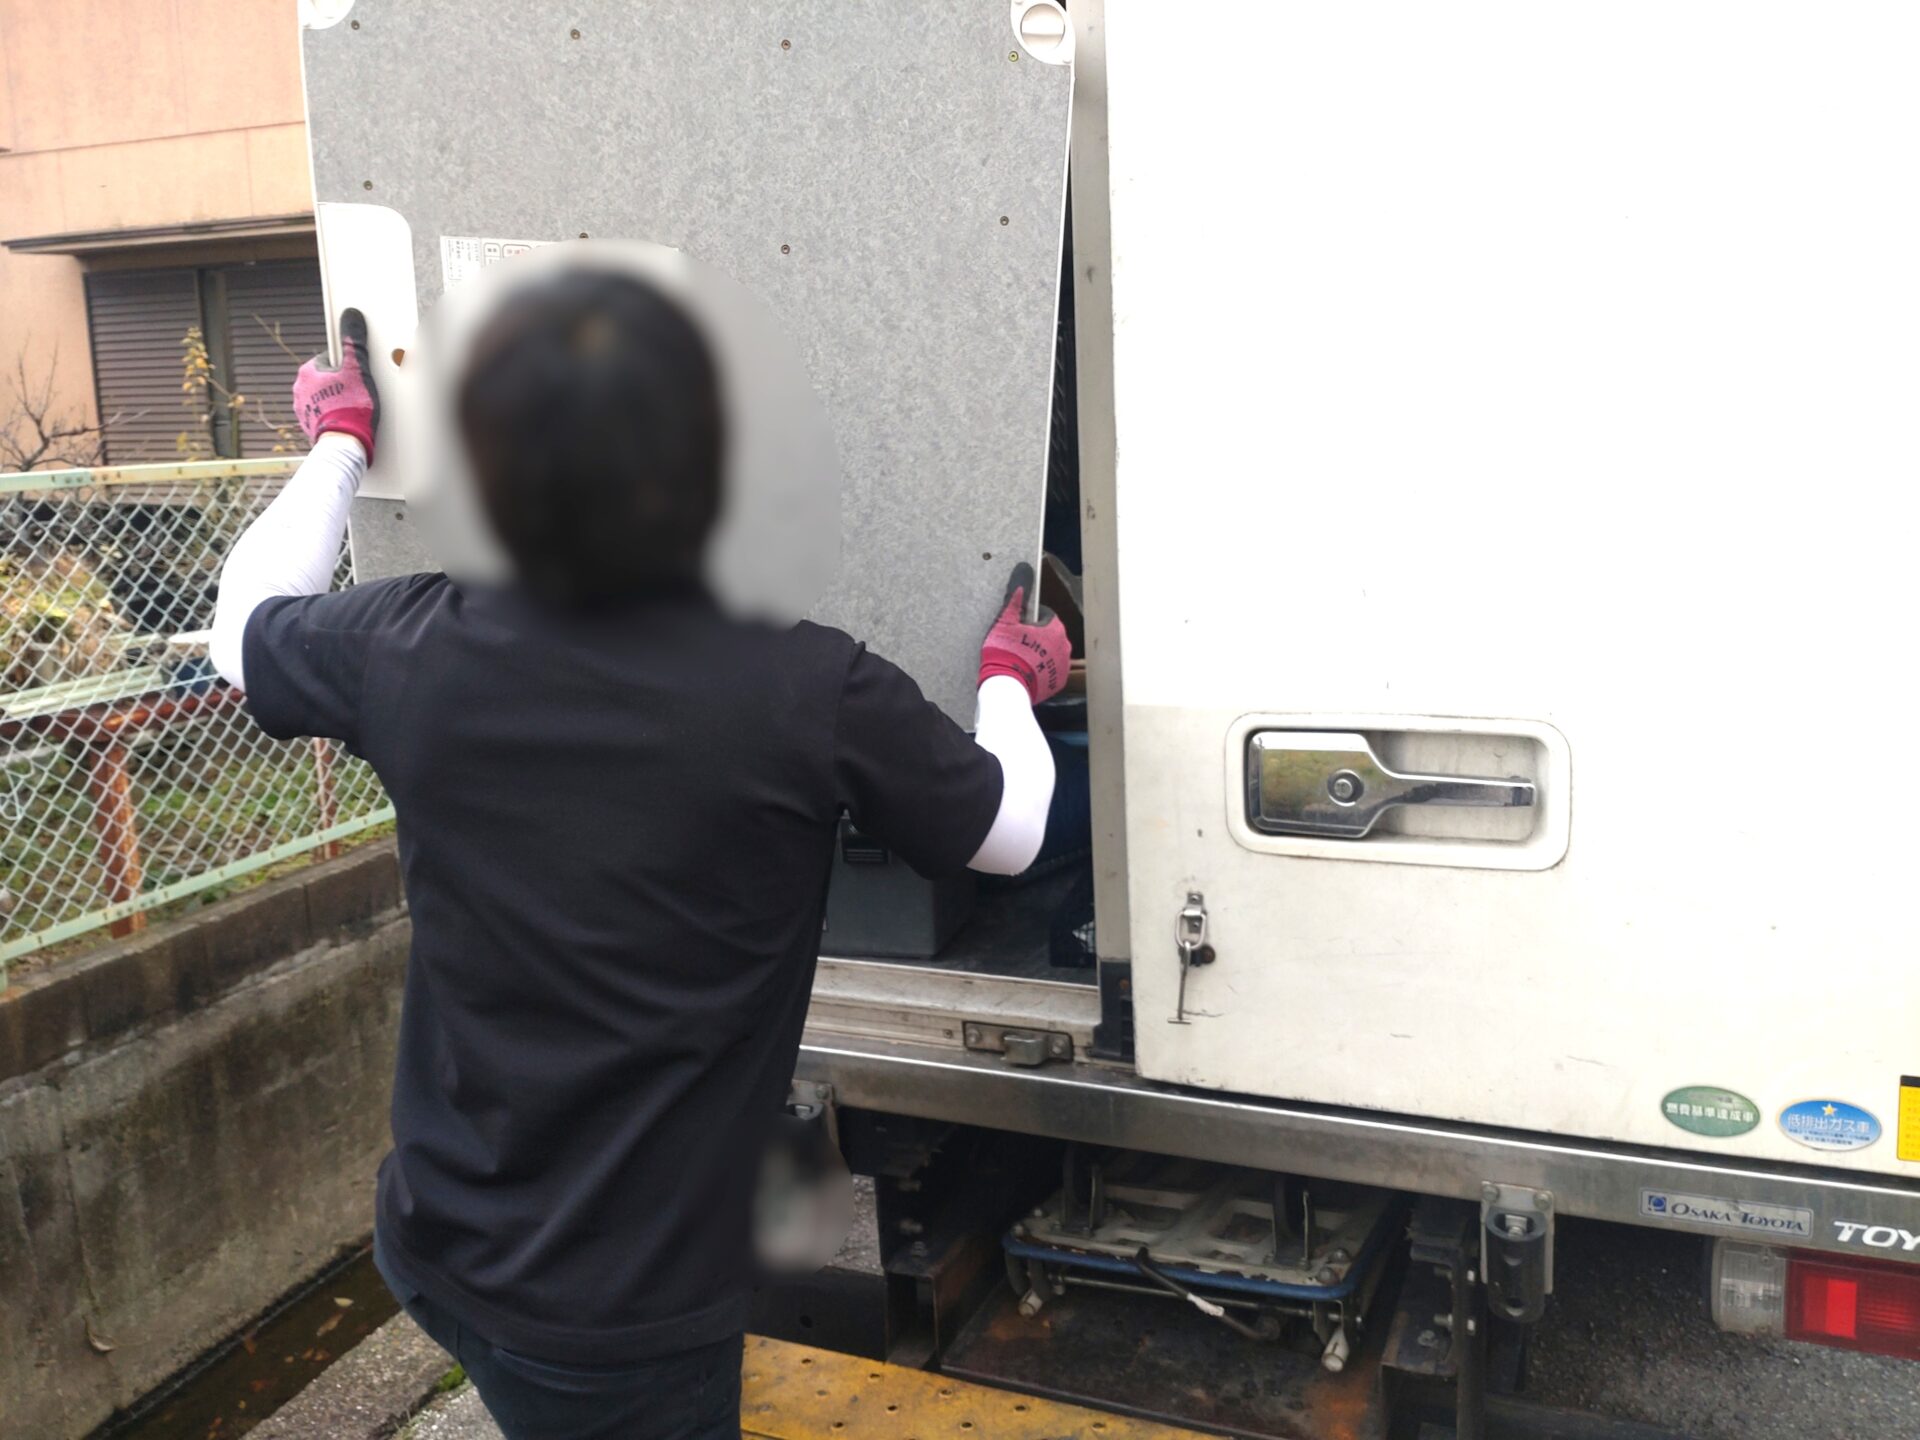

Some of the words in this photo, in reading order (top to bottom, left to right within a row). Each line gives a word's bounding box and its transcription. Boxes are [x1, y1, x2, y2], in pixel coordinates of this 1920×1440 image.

[1021, 634, 1047, 657] Lite
[1787, 1113, 1870, 1133] 低排出ガス車
